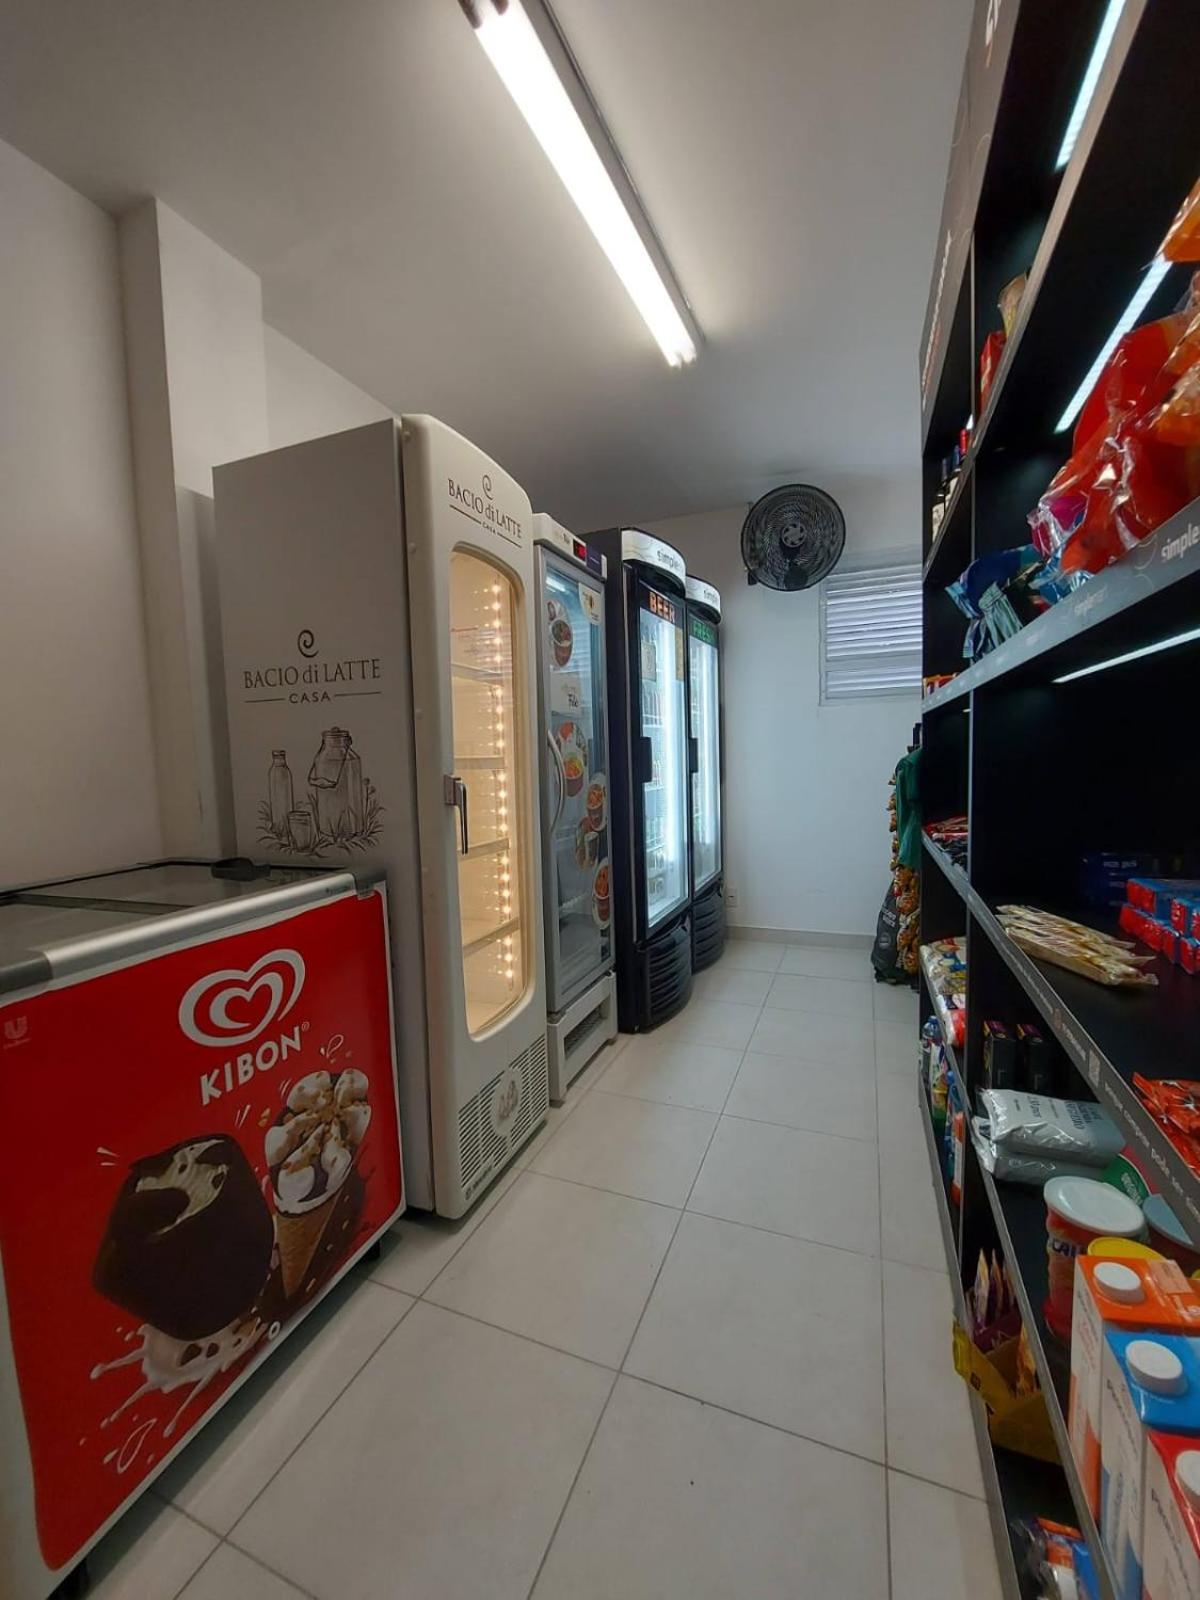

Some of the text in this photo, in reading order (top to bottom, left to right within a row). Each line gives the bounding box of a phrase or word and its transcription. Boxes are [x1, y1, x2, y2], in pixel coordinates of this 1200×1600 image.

[447, 478, 522, 539] BACIO di LATTE
[649, 591, 675, 624] BEER
[243, 658, 381, 688] BACIO di LATTE
[288, 690, 331, 704] CASA
[200, 1025, 301, 1106] KIBON
